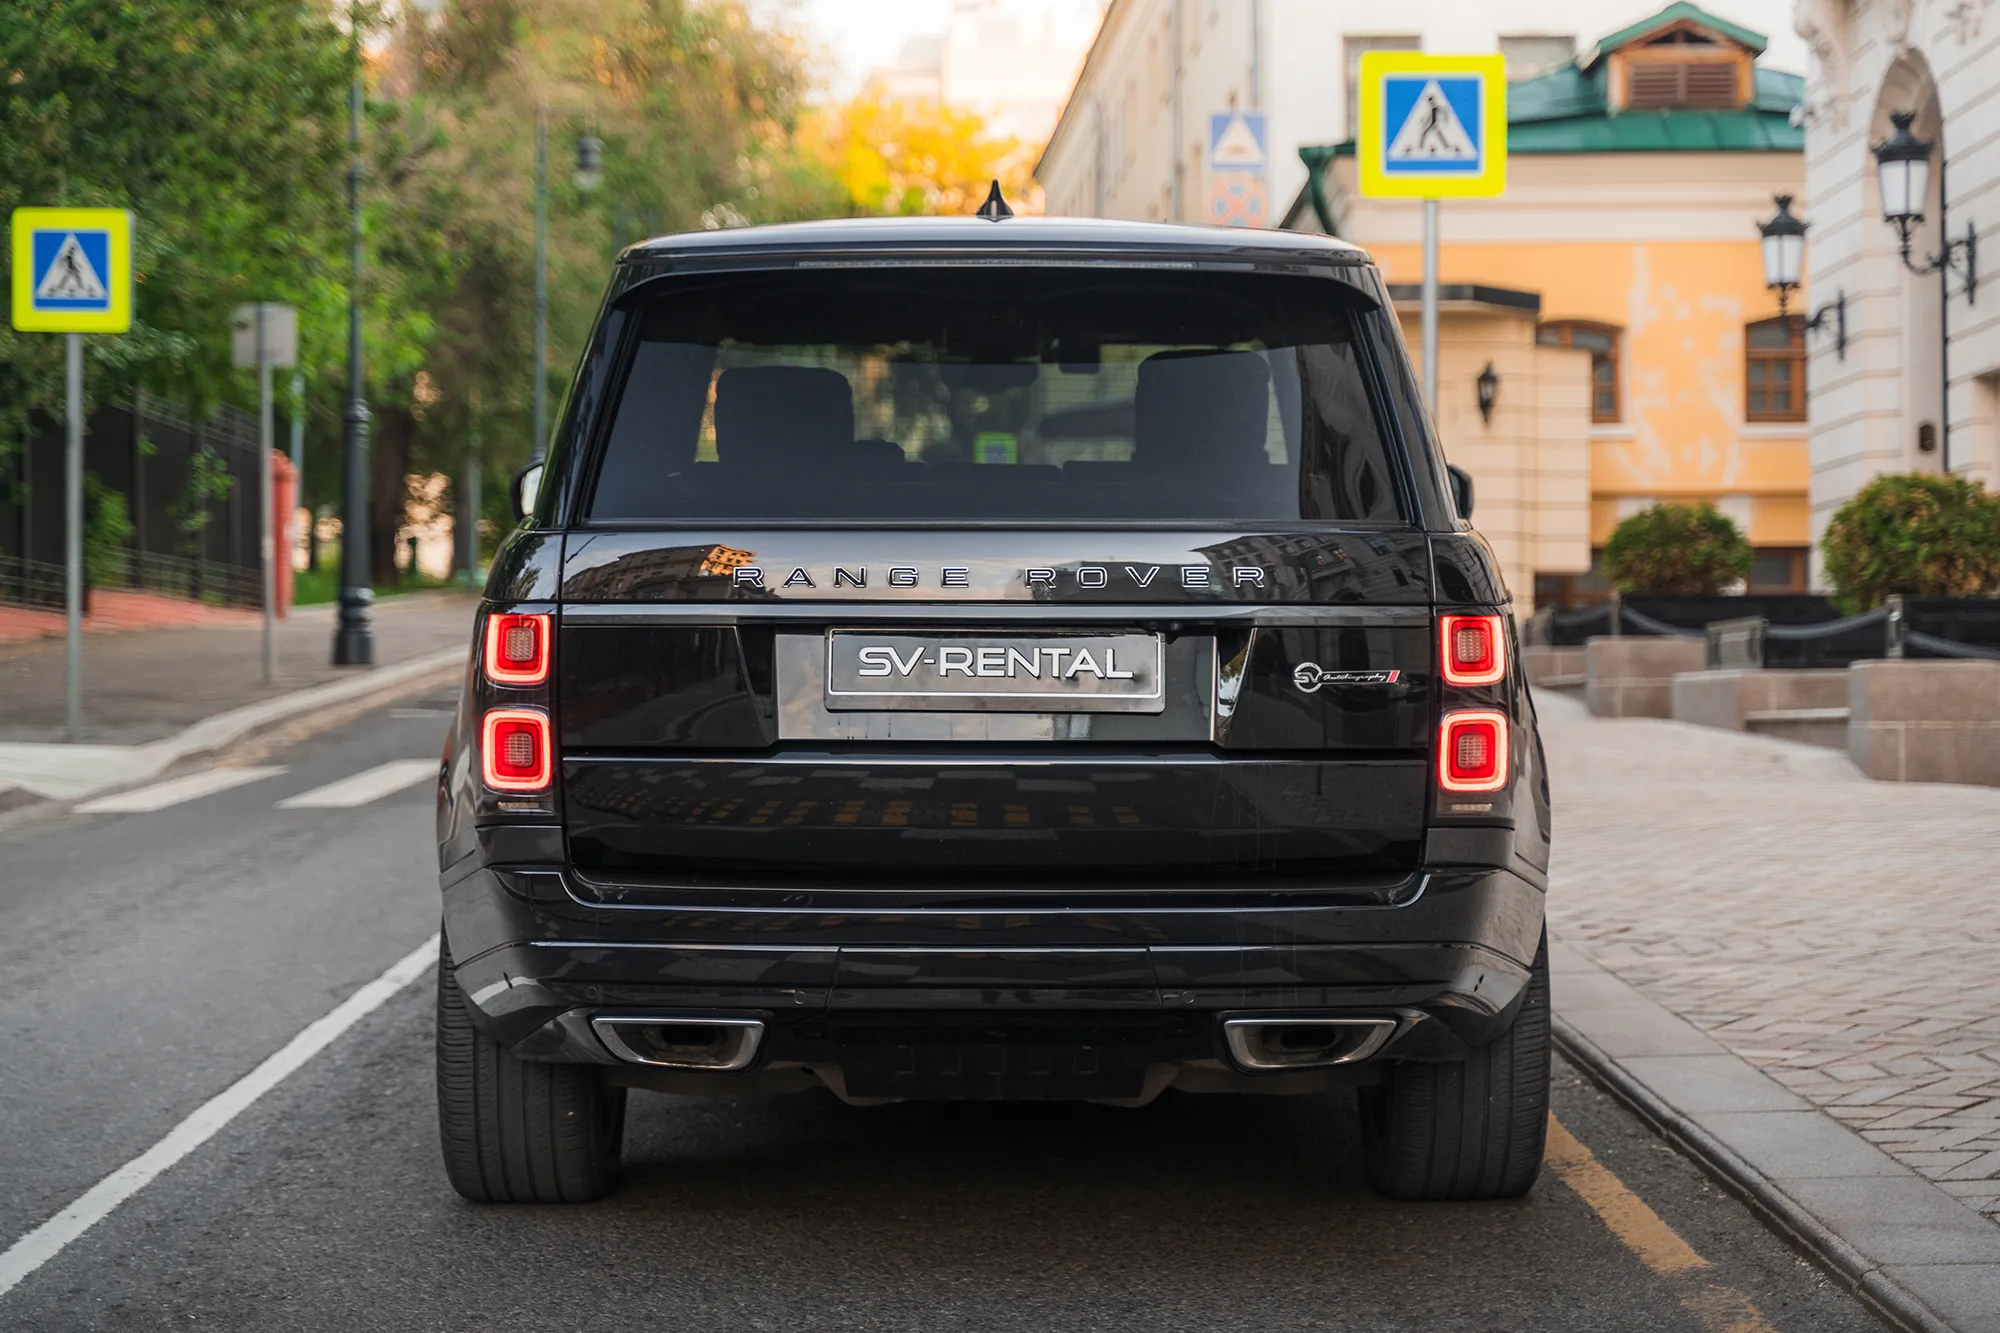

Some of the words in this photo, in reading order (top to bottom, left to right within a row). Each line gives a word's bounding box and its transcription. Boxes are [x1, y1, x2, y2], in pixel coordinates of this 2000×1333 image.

[732, 566, 969, 589] RANGE
[1025, 566, 1267, 589] ROVER
[858, 646, 1135, 680] SV-RENTAL
[1294, 670, 1321, 684] SV
